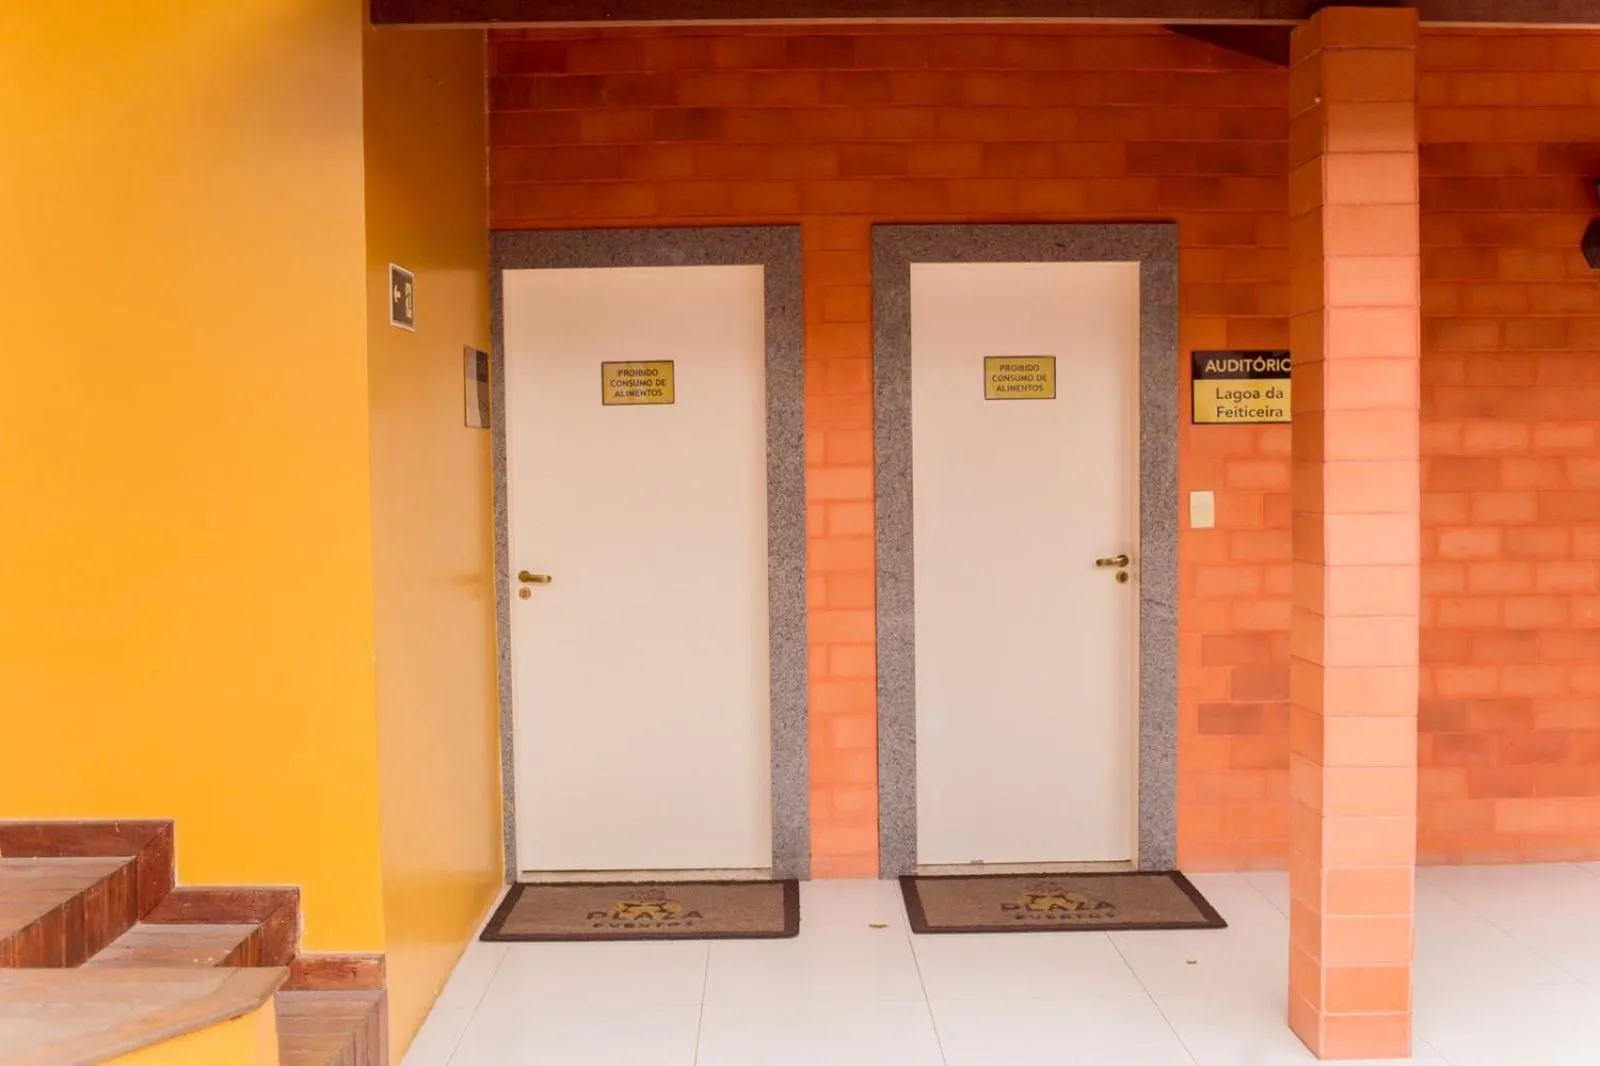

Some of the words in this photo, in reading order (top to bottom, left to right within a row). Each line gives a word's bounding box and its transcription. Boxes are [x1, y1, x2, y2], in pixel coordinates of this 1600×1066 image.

[1000, 364, 1039, 372] PROIBIDO
[1205, 356, 1292, 372] AUDITÓRIO
[617, 368, 659, 377] PROIBIDO
[996, 384, 1044, 392] ALIMENTOS
[615, 389, 663, 397] ALIMENTOS
[1216, 388, 1260, 402] Lagoa
[1265, 387, 1284, 399] da
[1216, 405, 1283, 418] Feiticeira
[1001, 901, 1116, 911] PLAZA
[586, 911, 704, 920] PLAZA
